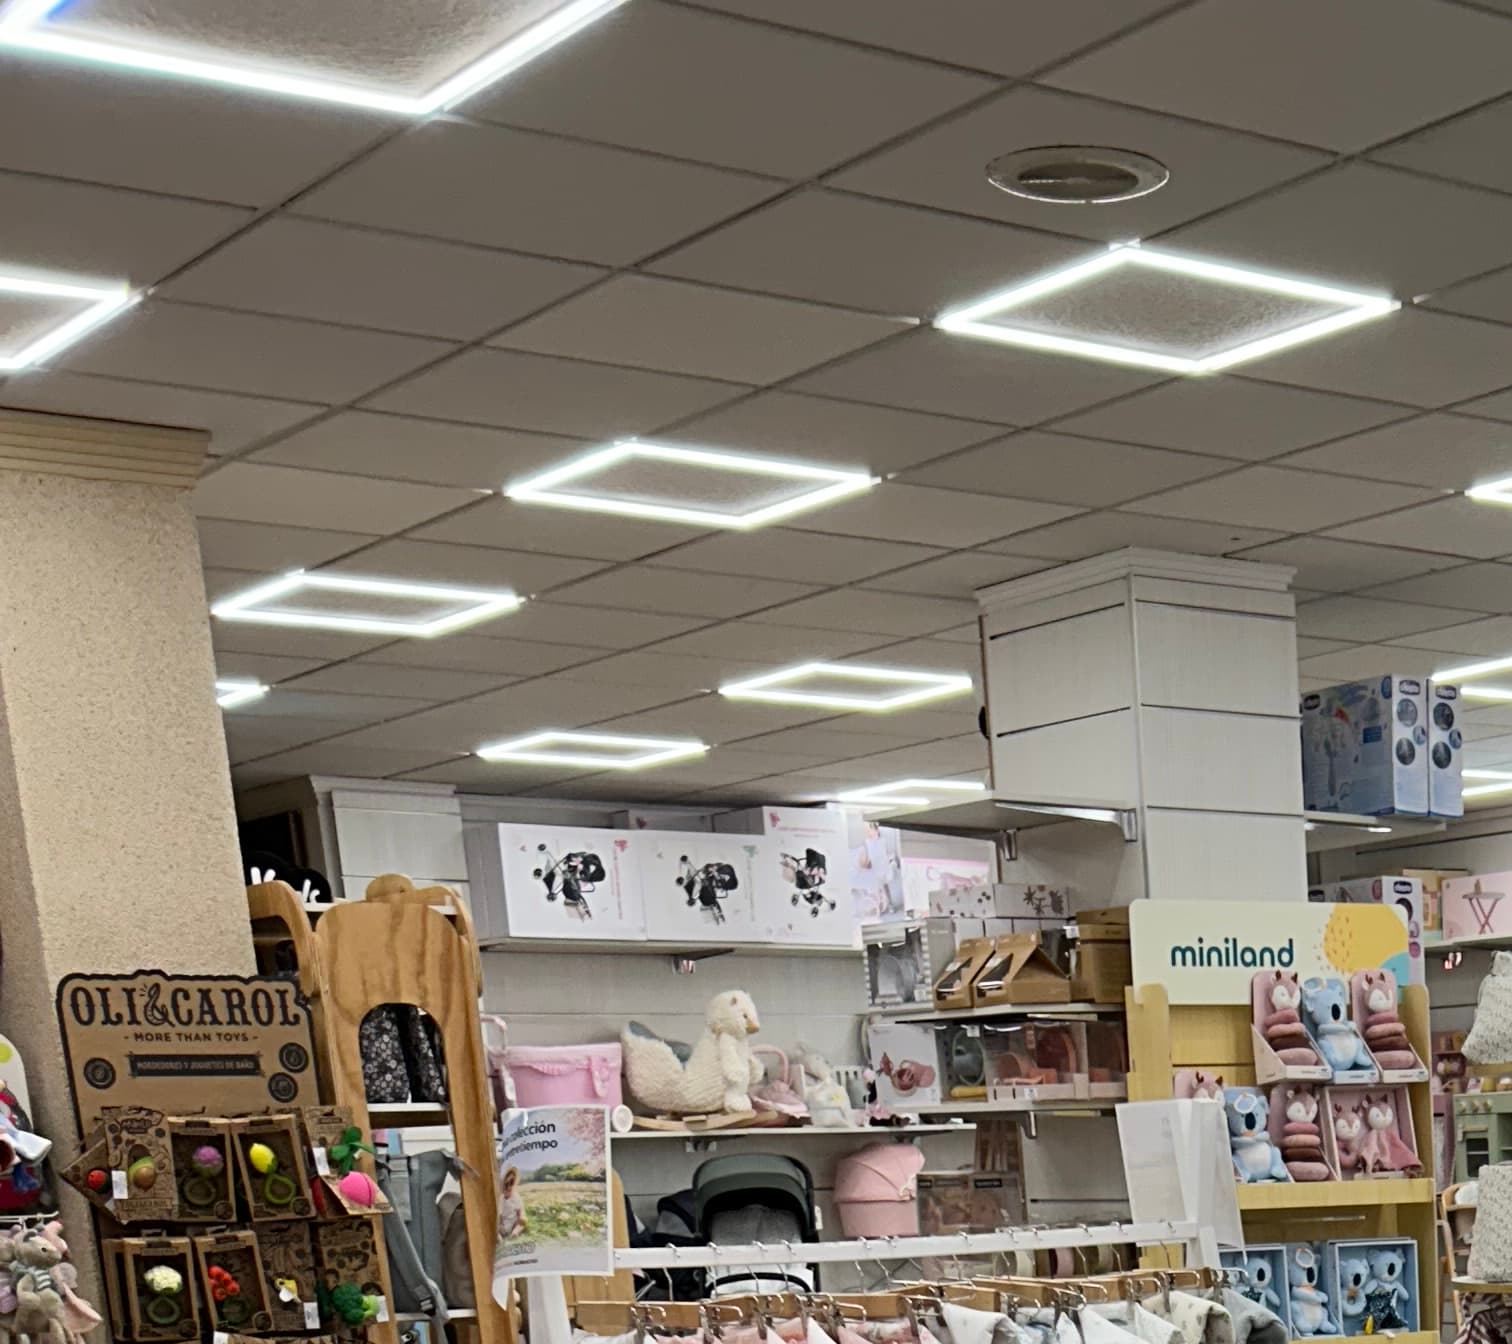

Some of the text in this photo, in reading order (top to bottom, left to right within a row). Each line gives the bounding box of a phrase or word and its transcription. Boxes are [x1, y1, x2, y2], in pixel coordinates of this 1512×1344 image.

[1170, 936, 1294, 968] miniland
[69, 981, 301, 1028] OLI&CAROL
[133, 1032, 250, 1043] MORE THAN TOYS
